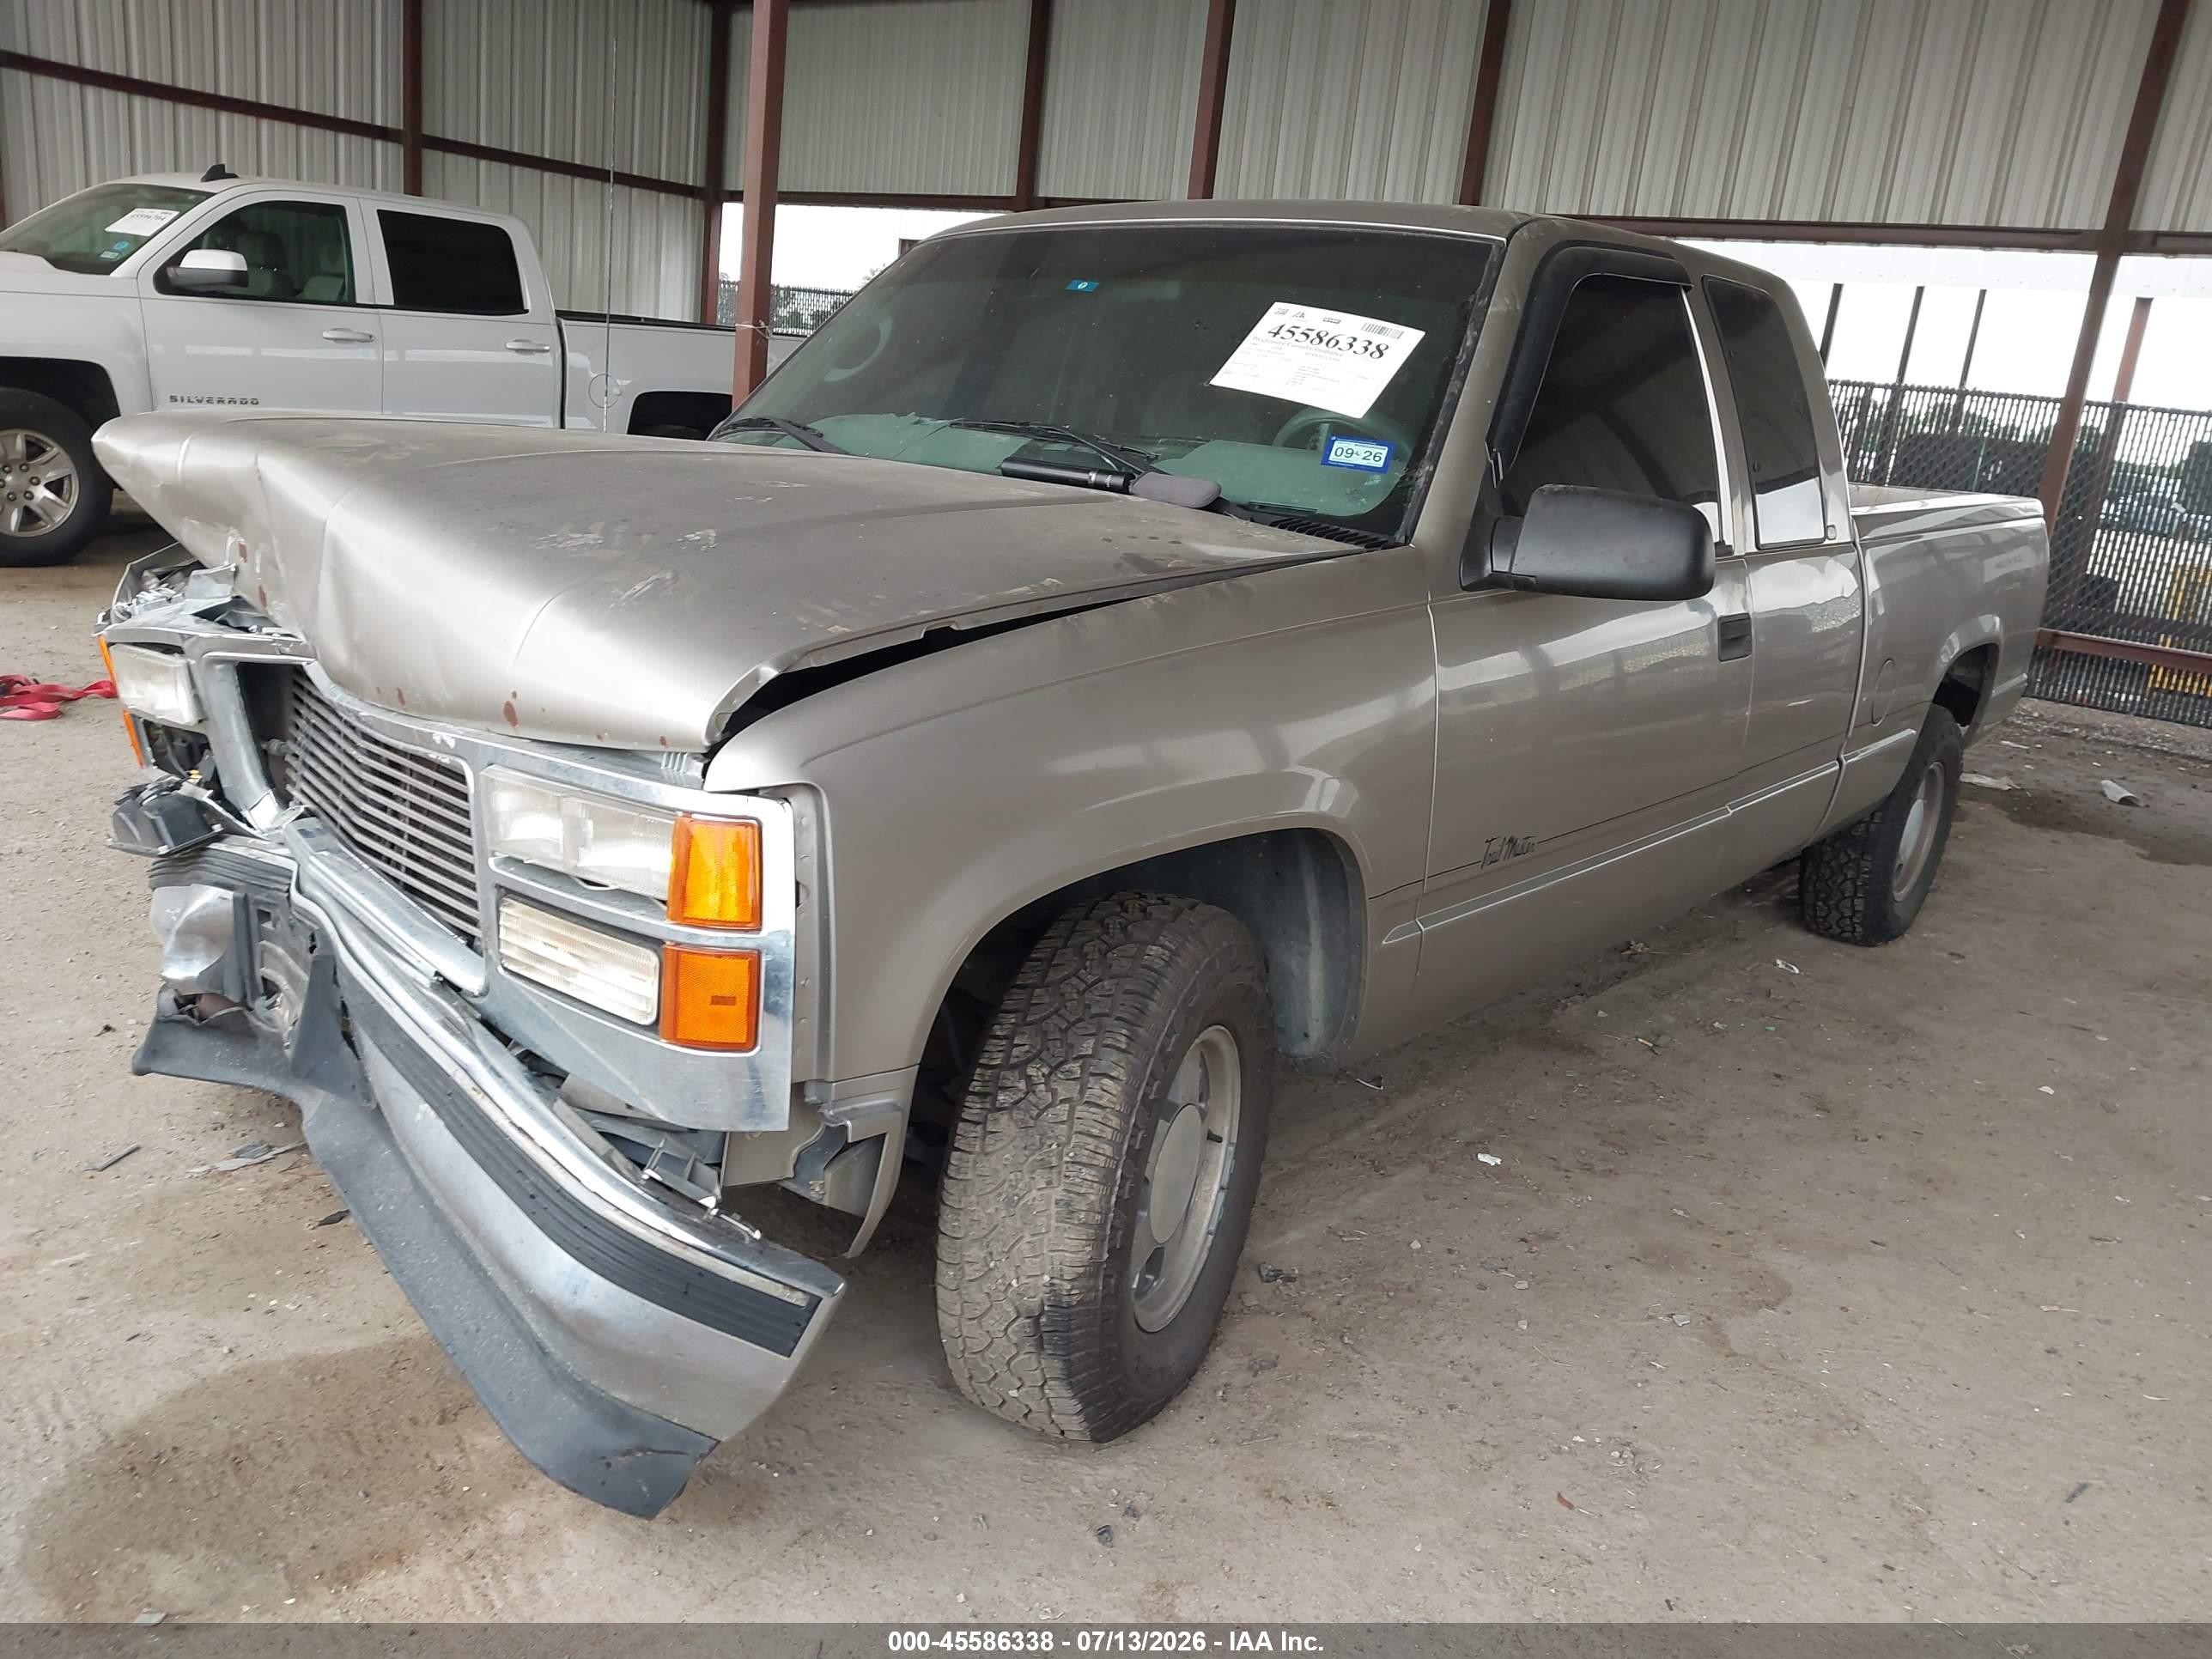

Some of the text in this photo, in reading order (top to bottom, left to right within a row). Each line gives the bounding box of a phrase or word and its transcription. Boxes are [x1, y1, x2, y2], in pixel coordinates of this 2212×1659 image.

[1267, 323, 1389, 360] 45586338
[169, 394, 260, 405] SILVERADO
[1334, 447, 1383, 463] 09 26
